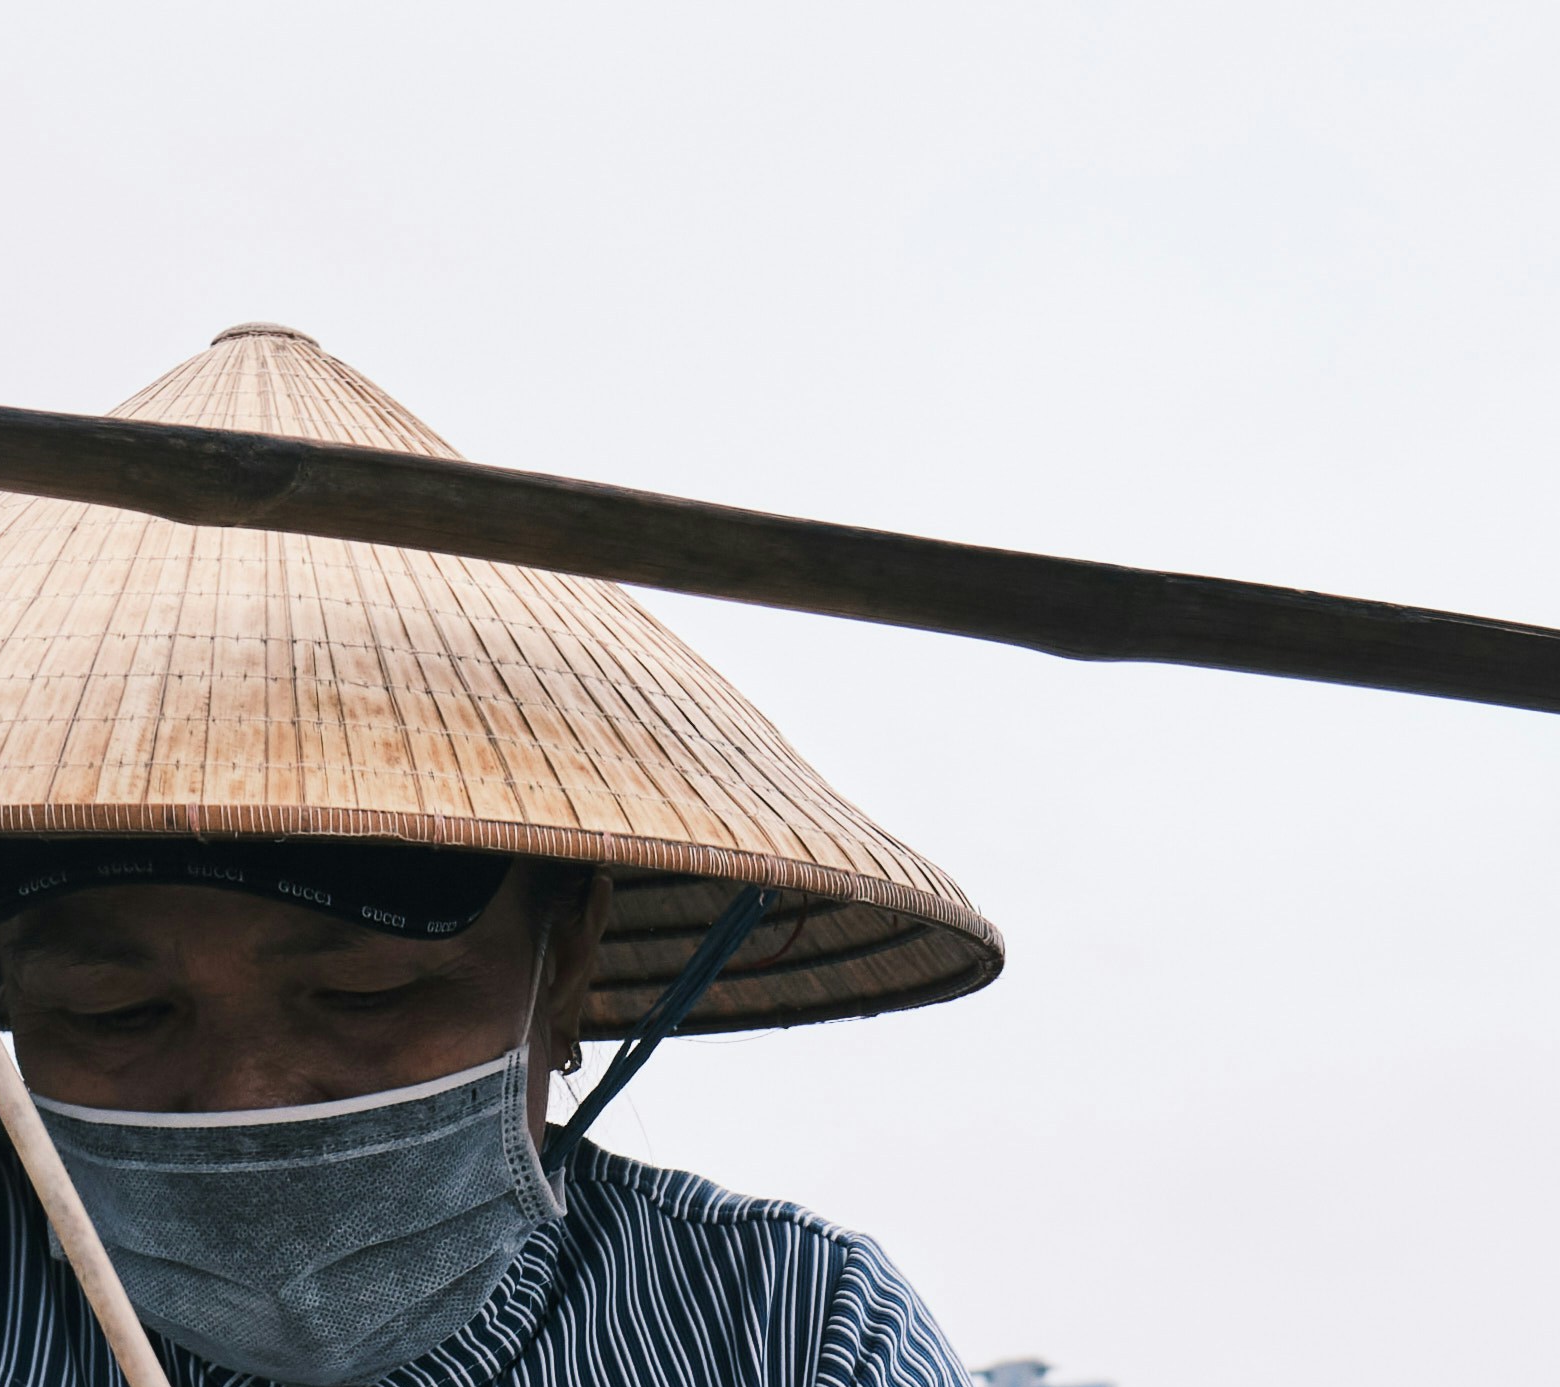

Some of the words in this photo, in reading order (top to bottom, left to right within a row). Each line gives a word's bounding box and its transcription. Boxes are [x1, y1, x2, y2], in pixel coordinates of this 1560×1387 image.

[18, 870, 68, 896] GUCCI
[278, 880, 333, 906] GUCCI
[361, 905, 406, 928] GUCCI
[427, 920, 457, 933] GUCCI
